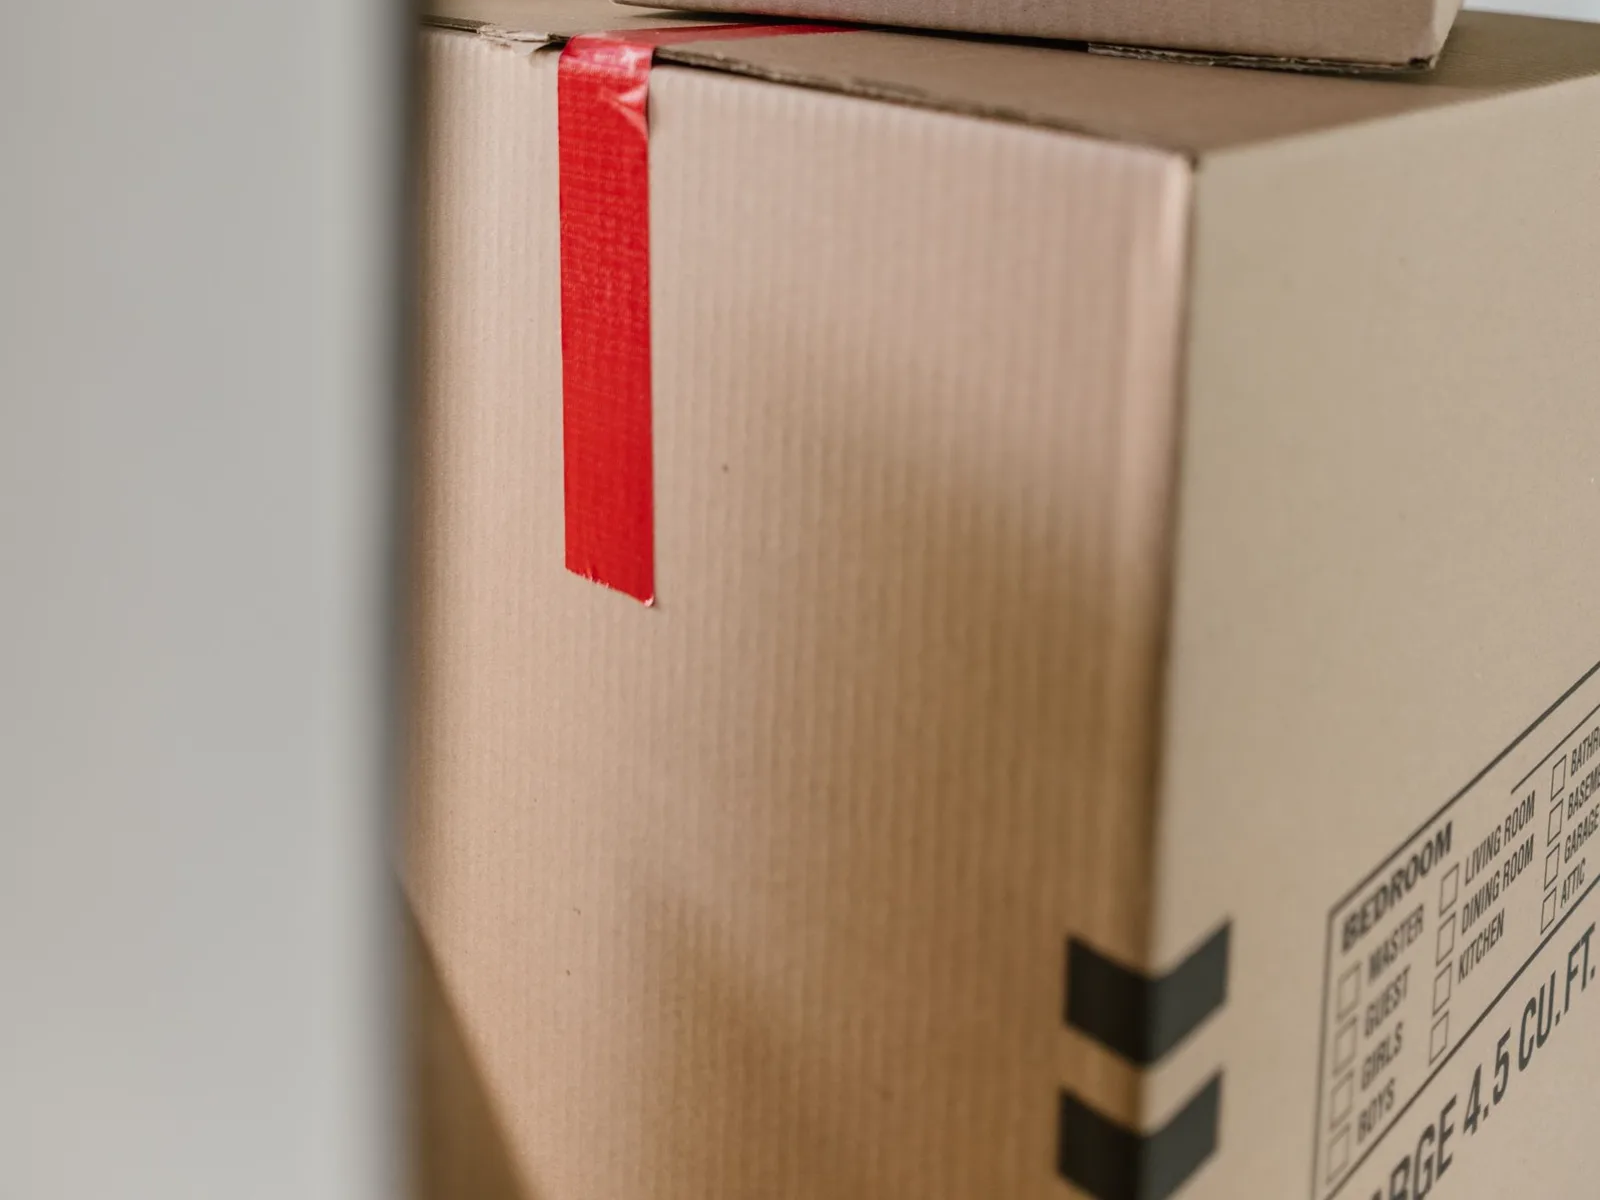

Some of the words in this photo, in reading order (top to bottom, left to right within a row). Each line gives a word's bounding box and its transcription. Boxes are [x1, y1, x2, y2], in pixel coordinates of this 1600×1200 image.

[1571, 726, 1600, 777] BATHR
[1465, 825, 1501, 886] LIVING
[1504, 790, 1536, 846] ROOM
[1564, 803, 1600, 864] GARAGE
[1342, 820, 1453, 957] BEDROOM
[1461, 870, 1500, 935] DINING
[1502, 833, 1534, 891] ROOM
[1560, 857, 1586, 909] ATTIC
[1368, 904, 1424, 986] MASTER
[1458, 908, 1505, 984] KITCHEN
[1364, 964, 1411, 1038] GUEST
[1361, 1020, 1403, 1092] GIRLS
[1356, 1077, 1396, 1143] BOYS
[1370, 1094, 1458, 1200] RGE
[1463, 1027, 1512, 1136] 4.5
